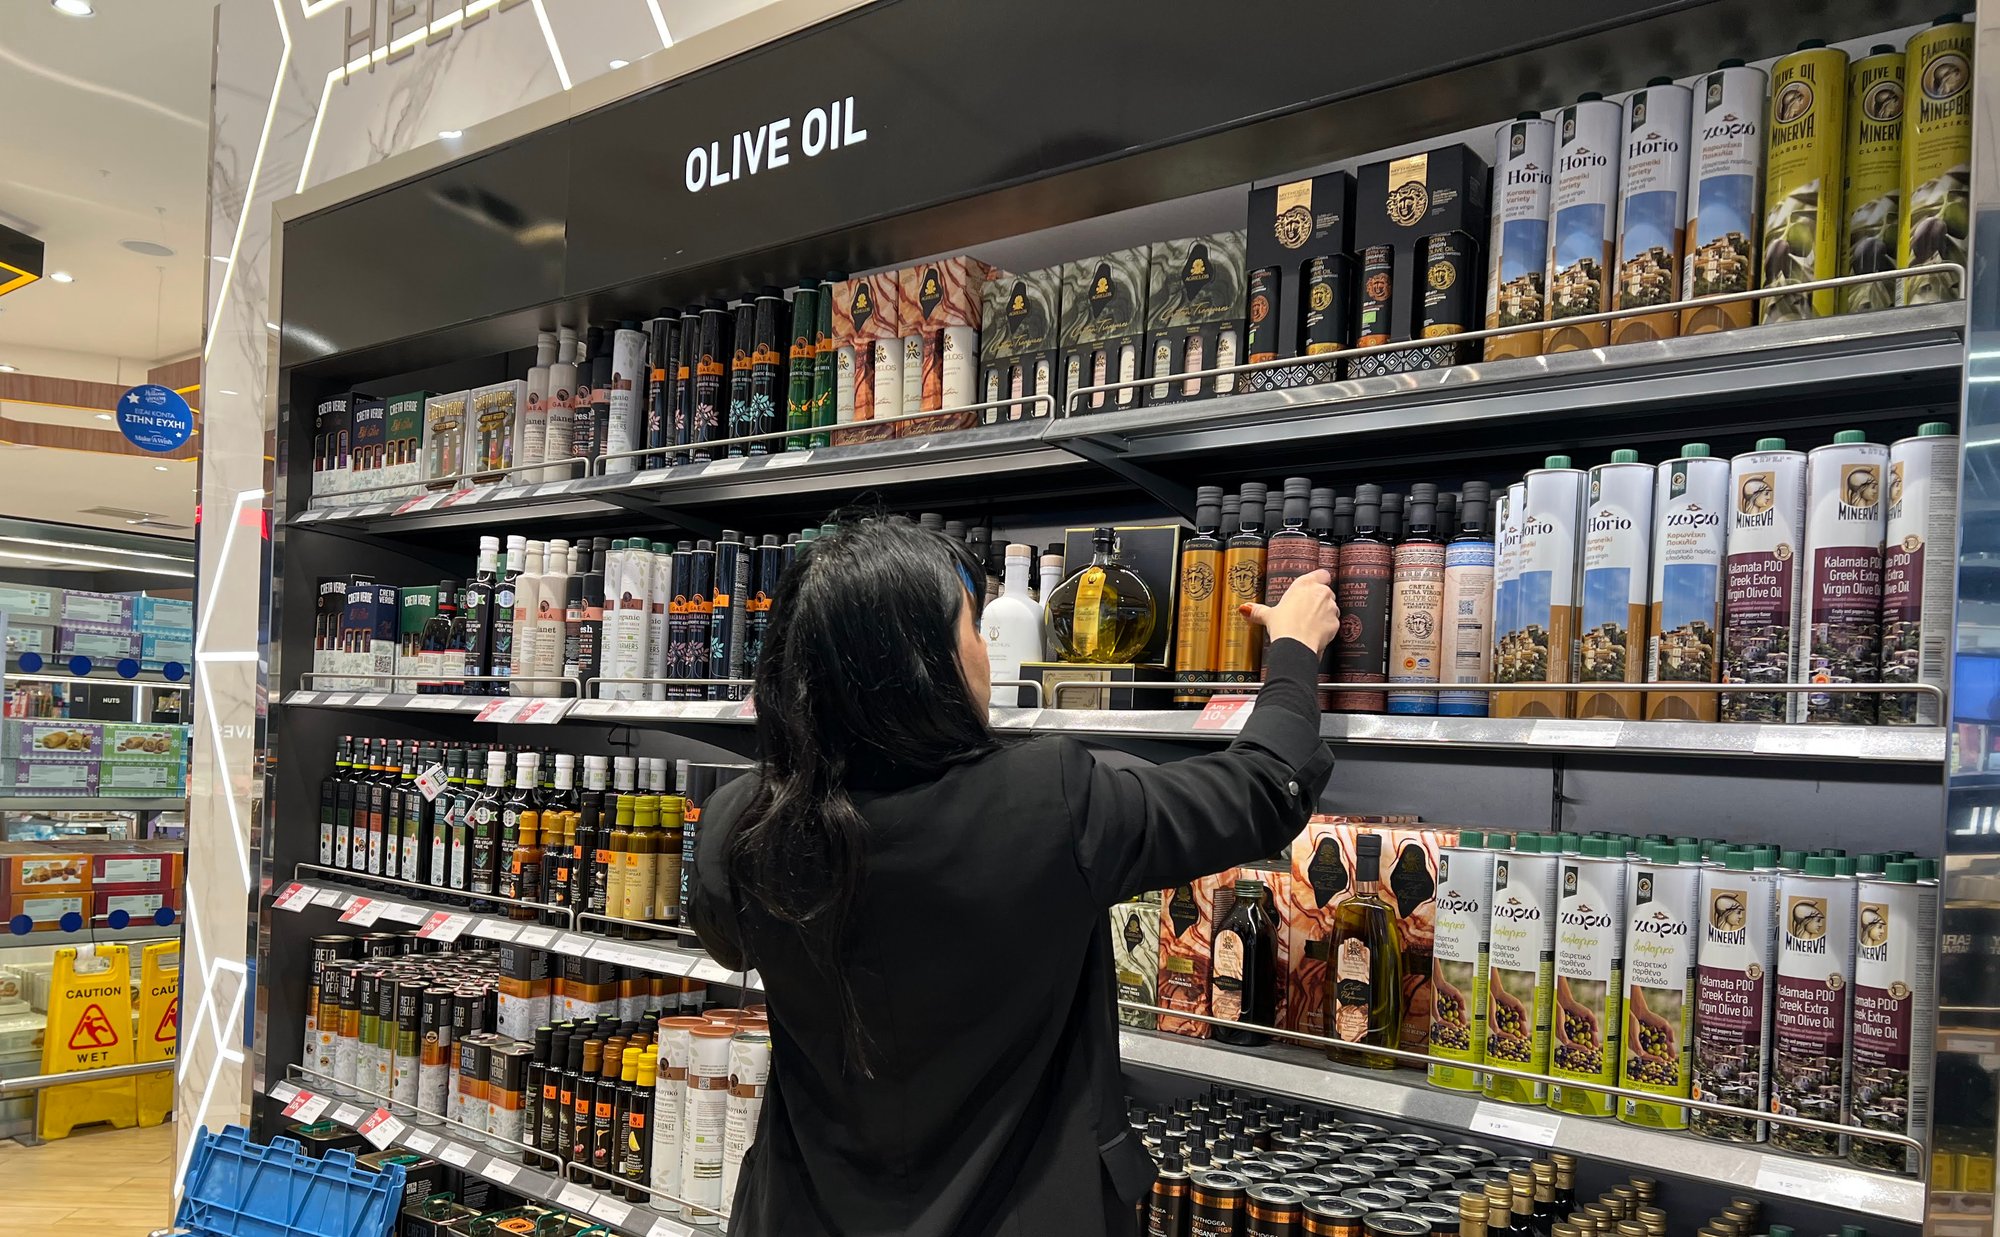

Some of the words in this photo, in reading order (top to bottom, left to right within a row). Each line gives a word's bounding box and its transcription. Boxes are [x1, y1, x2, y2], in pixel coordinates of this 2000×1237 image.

[1774, 67, 1794, 88] OLIVE
[1800, 62, 1816, 85] OIL
[1862, 67, 1889, 92] OLIVE
[1703, 122, 1755, 141] χωριό
[1772, 113, 1815, 148] MINERVA
[685, 117, 790, 192] OLIVE
[802, 96, 867, 157] OIL
[1629, 140, 1679, 159] Horio
[1560, 154, 1607, 173] Horio
[1507, 168, 1551, 186] Horio
[1160, 306, 1190, 321] Cretan
[1192, 302, 1230, 314] Treasures
[151, 411, 175, 419] ΚΟΝΤΑ
[318, 403, 331, 415] CRETA
[332, 400, 347, 412] VERDE
[356, 410, 369, 422] CRETA
[370, 408, 384, 420] VERDE
[389, 403, 402, 415] CRETA
[403, 400, 418, 412] VERDE
[125, 413, 153, 425] ΣΤΗΝ
[1736, 507, 1773, 528] MINERVA
[1838, 502, 1878, 521] MINERVA
[1588, 516, 1632, 533] Horio
[1667, 512, 1719, 529] χωριό
[1728, 562, 1761, 573] Kalamata
[1764, 560, 1783, 572] PDO
[1824, 556, 1868, 568] Kalamata
[1893, 554, 1910, 566] PDO
[1730, 575, 1751, 586] Greek
[1753, 574, 1776, 585] Extra
[1829, 569, 1858, 582] Greek
[1860, 570, 1879, 581] Extra
[379, 589, 395, 597] CRETA
[1746, 587, 1769, 598] Olive
[1771, 586, 1782, 598] Oil
[1822, 584, 1851, 597] Virgin
[1853, 583, 1874, 595] Olive
[1898, 581, 1910, 593] Oil
[378, 596, 395, 605] VERDE
[405, 595, 416, 607] CRETA
[417, 594, 431, 606] VERDE
[1494, 903, 1540, 923] χωριό
[1561, 911, 1612, 931] χωριό
[1634, 918, 1688, 939] χωριό
[1708, 926, 1745, 945] MINERVA
[1785, 932, 1826, 954] MINERVA
[1632, 959, 1668, 972] εξαιρετικό
[1632, 966, 1661, 978] παρθένο
[1631, 974, 1669, 986] ελαιόλαδο
[1700, 975, 1734, 990] Kalamata
[1736, 979, 1754, 992] PDO
[66, 987, 121, 999] CAUTION
[1702, 988, 1723, 1001] Greek
[1725, 992, 1748, 1004] Extra
[1778, 984, 1814, 1000] Kalamata
[1816, 989, 1835, 1002] PDO
[1719, 1004, 1740, 1017] Olive
[1742, 1006, 1754, 1018] Oil
[1780, 998, 1802, 1012] Greek
[1804, 1002, 1828, 1015] Extra
[1877, 999, 1898, 1012] PDO
[1798, 1014, 1821, 1028] Olive
[1823, 1016, 1834, 1029] Oil
[1867, 1012, 1891, 1024] Extra
[1862, 1023, 1882, 1037] Olive
[1884, 1026, 1898, 1039] Oil
[77, 1052, 108, 1063] WET
[462, 1046, 475, 1058] CRETA
[461, 1056, 475, 1069] VERDE
[1192, 1214, 1226, 1226] MYTHOGEA
